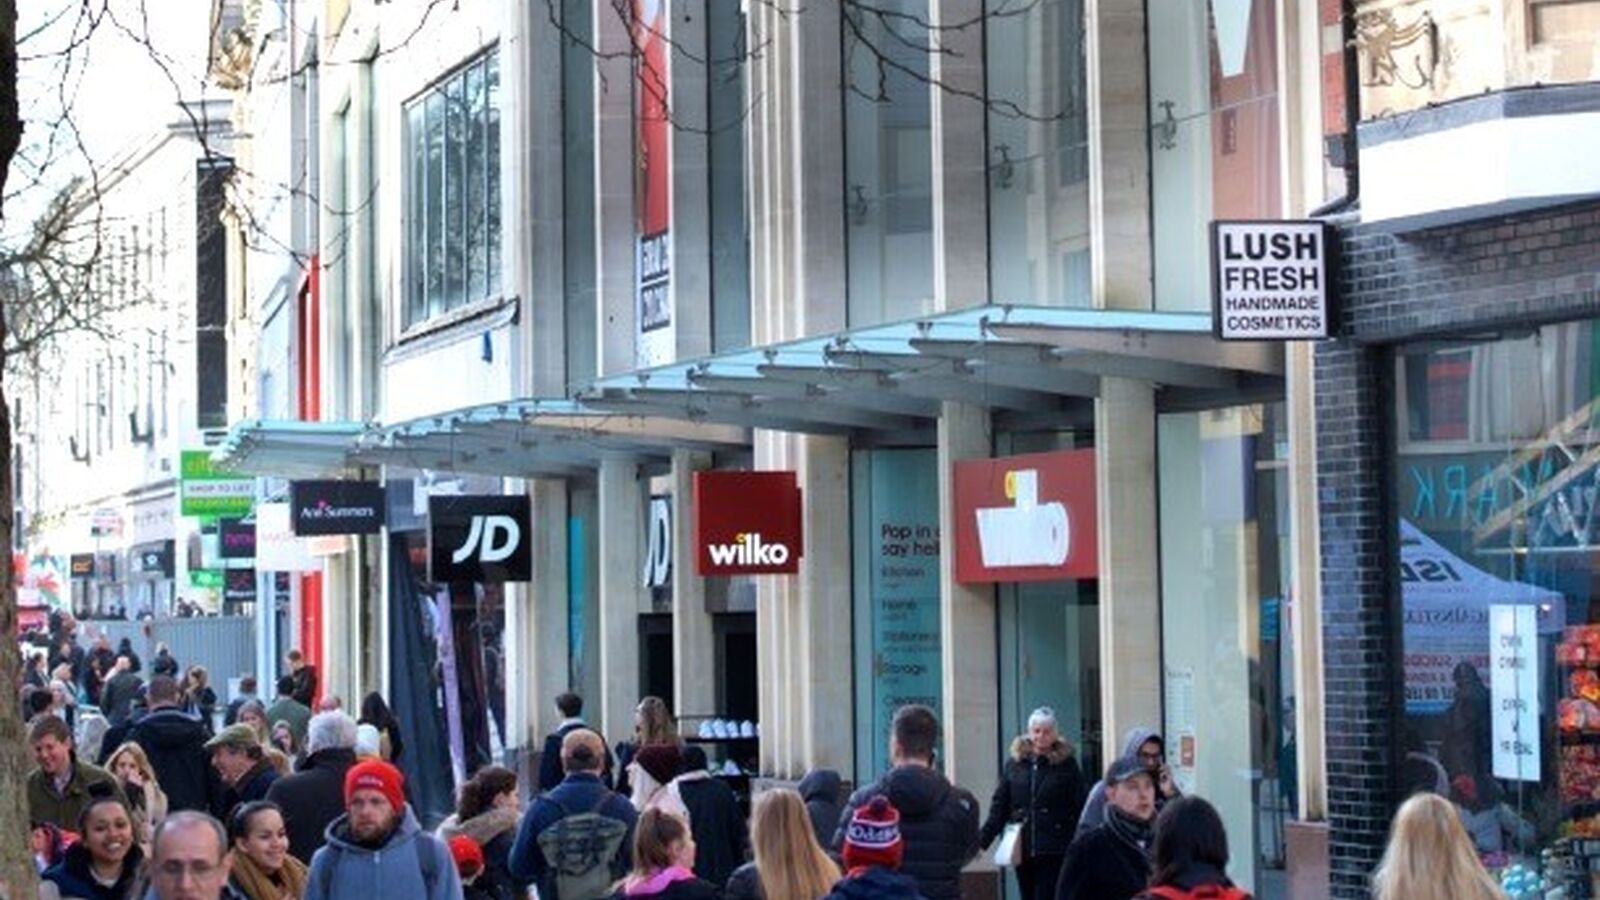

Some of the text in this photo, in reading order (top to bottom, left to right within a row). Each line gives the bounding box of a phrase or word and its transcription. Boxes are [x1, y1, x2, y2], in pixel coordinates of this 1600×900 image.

[1223, 233, 1318, 260] LUSH
[1224, 266, 1319, 291] FRESH
[1226, 297, 1320, 311] HANDMADE
[1227, 315, 1321, 331] COSMETICS
[452, 515, 520, 564] JD
[881, 523, 912, 540] Pop
[916, 523, 931, 538] in
[708, 533, 788, 565] wilko
[881, 542, 908, 558] say
